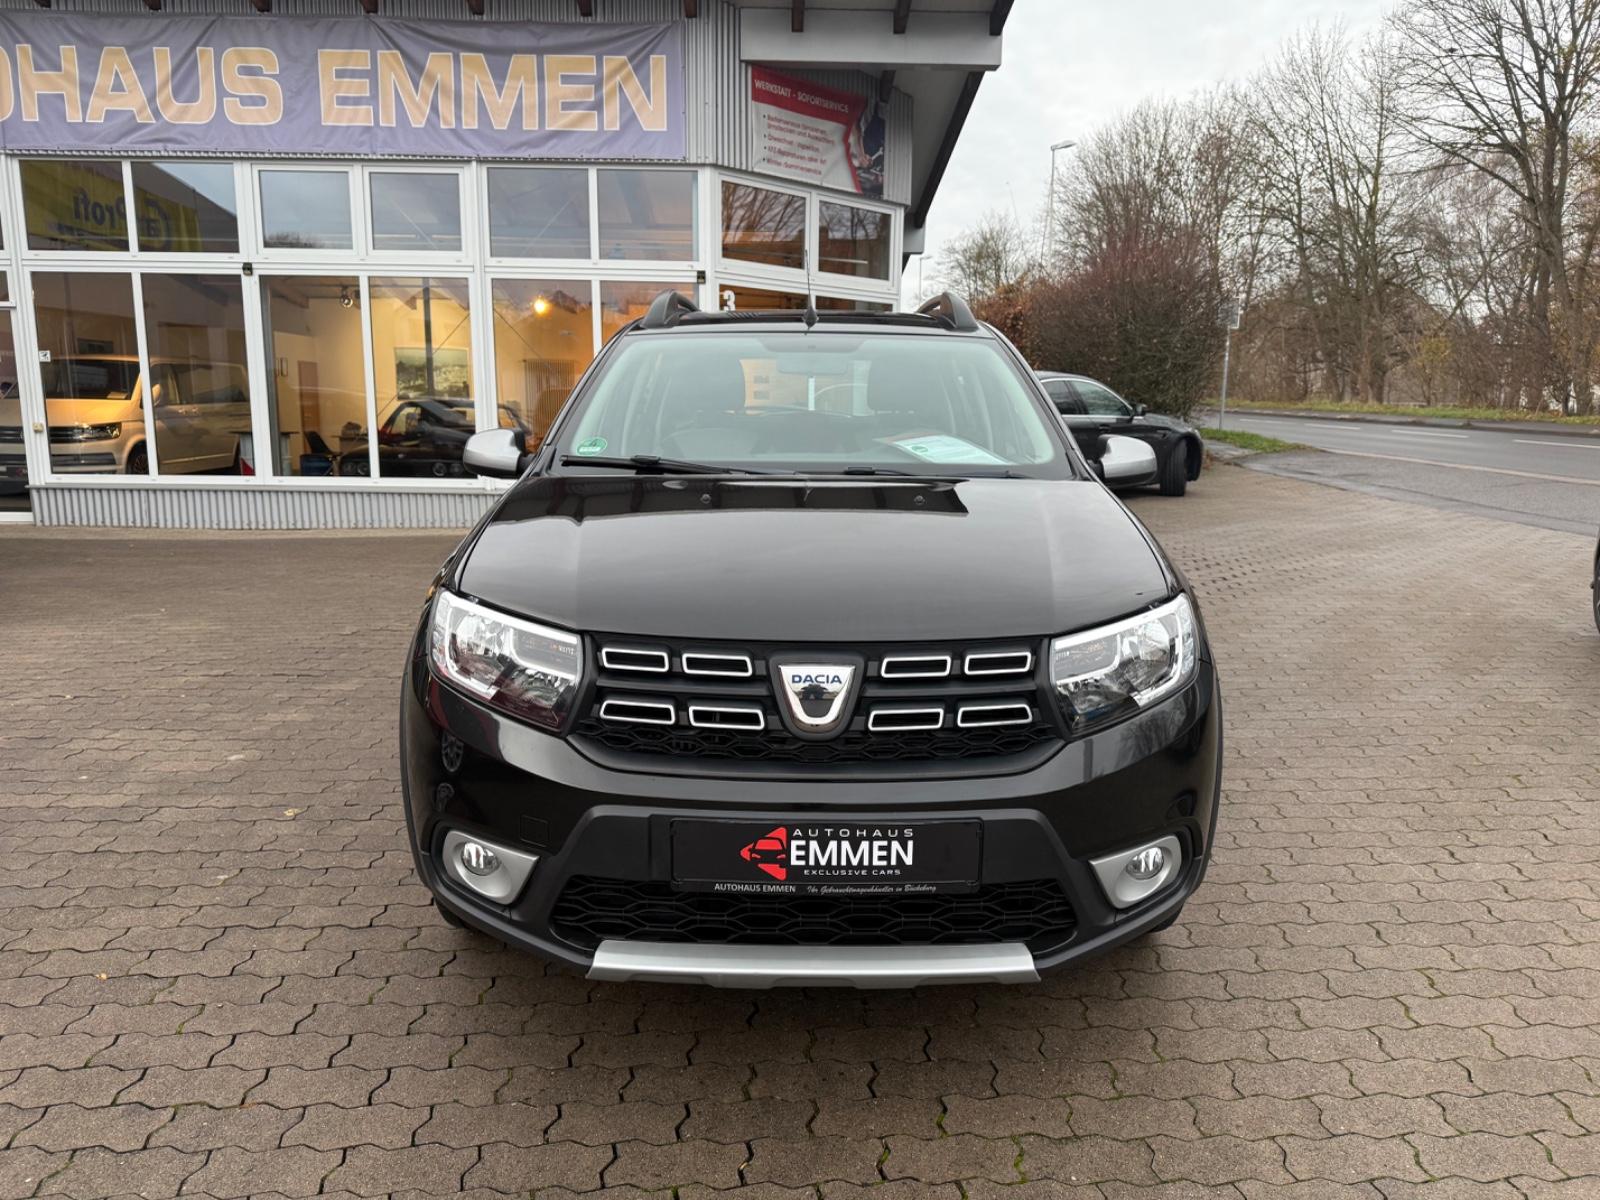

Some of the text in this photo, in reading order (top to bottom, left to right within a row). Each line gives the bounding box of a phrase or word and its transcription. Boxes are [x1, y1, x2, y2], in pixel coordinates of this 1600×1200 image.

[0, 44, 668, 131] HAUS EMMEN
[754, 79, 792, 98] WERKSTATT
[797, 91, 849, 113] SOFORTSERVICE
[791, 674, 842, 684] DACIA
[792, 828, 914, 837] AUTOHAUS
[790, 839, 914, 866] EMMEN
[714, 883, 761, 892] AUTOHAUS
[762, 884, 796, 893] EMMEN
